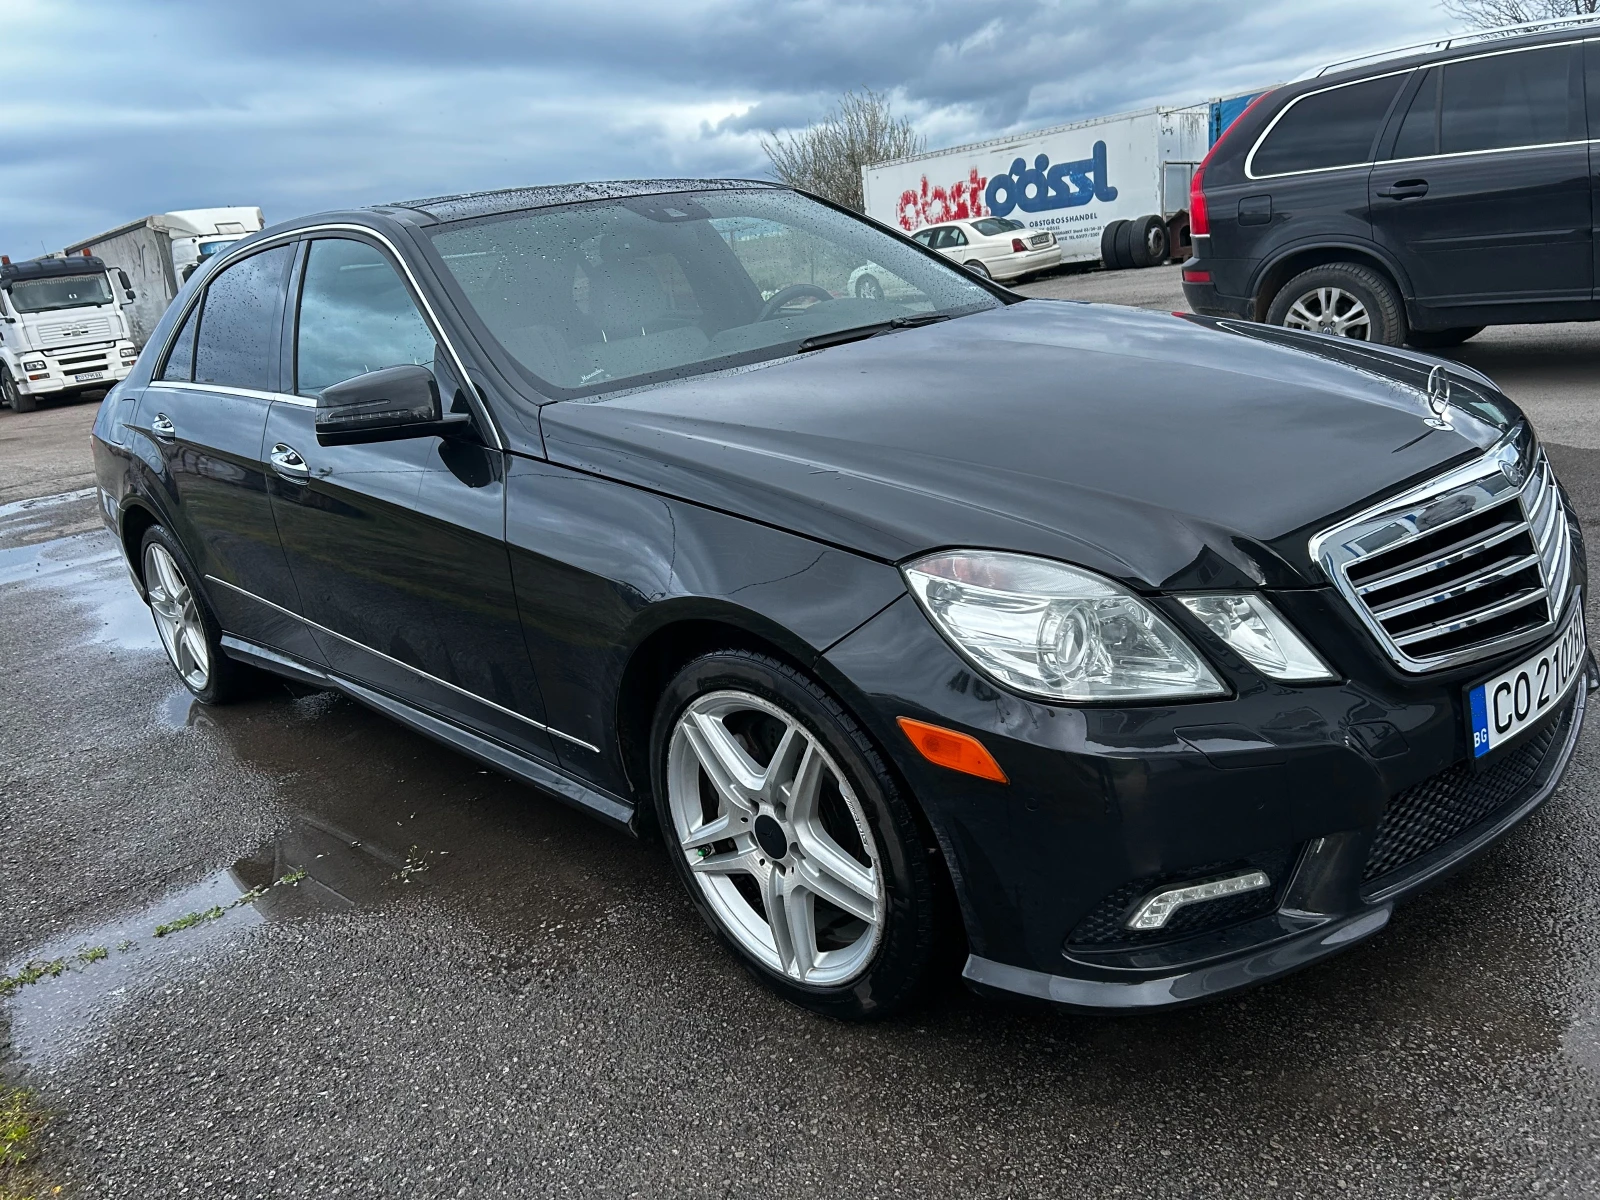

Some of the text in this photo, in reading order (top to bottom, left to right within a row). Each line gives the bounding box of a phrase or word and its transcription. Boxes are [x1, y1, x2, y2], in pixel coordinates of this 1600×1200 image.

[1029, 213, 1097, 227] OBSTGROSSHANDEL
[1492, 671, 1531, 734] CO
[1536, 626, 1575, 711] 2102
[1473, 728, 1487, 748] BG
